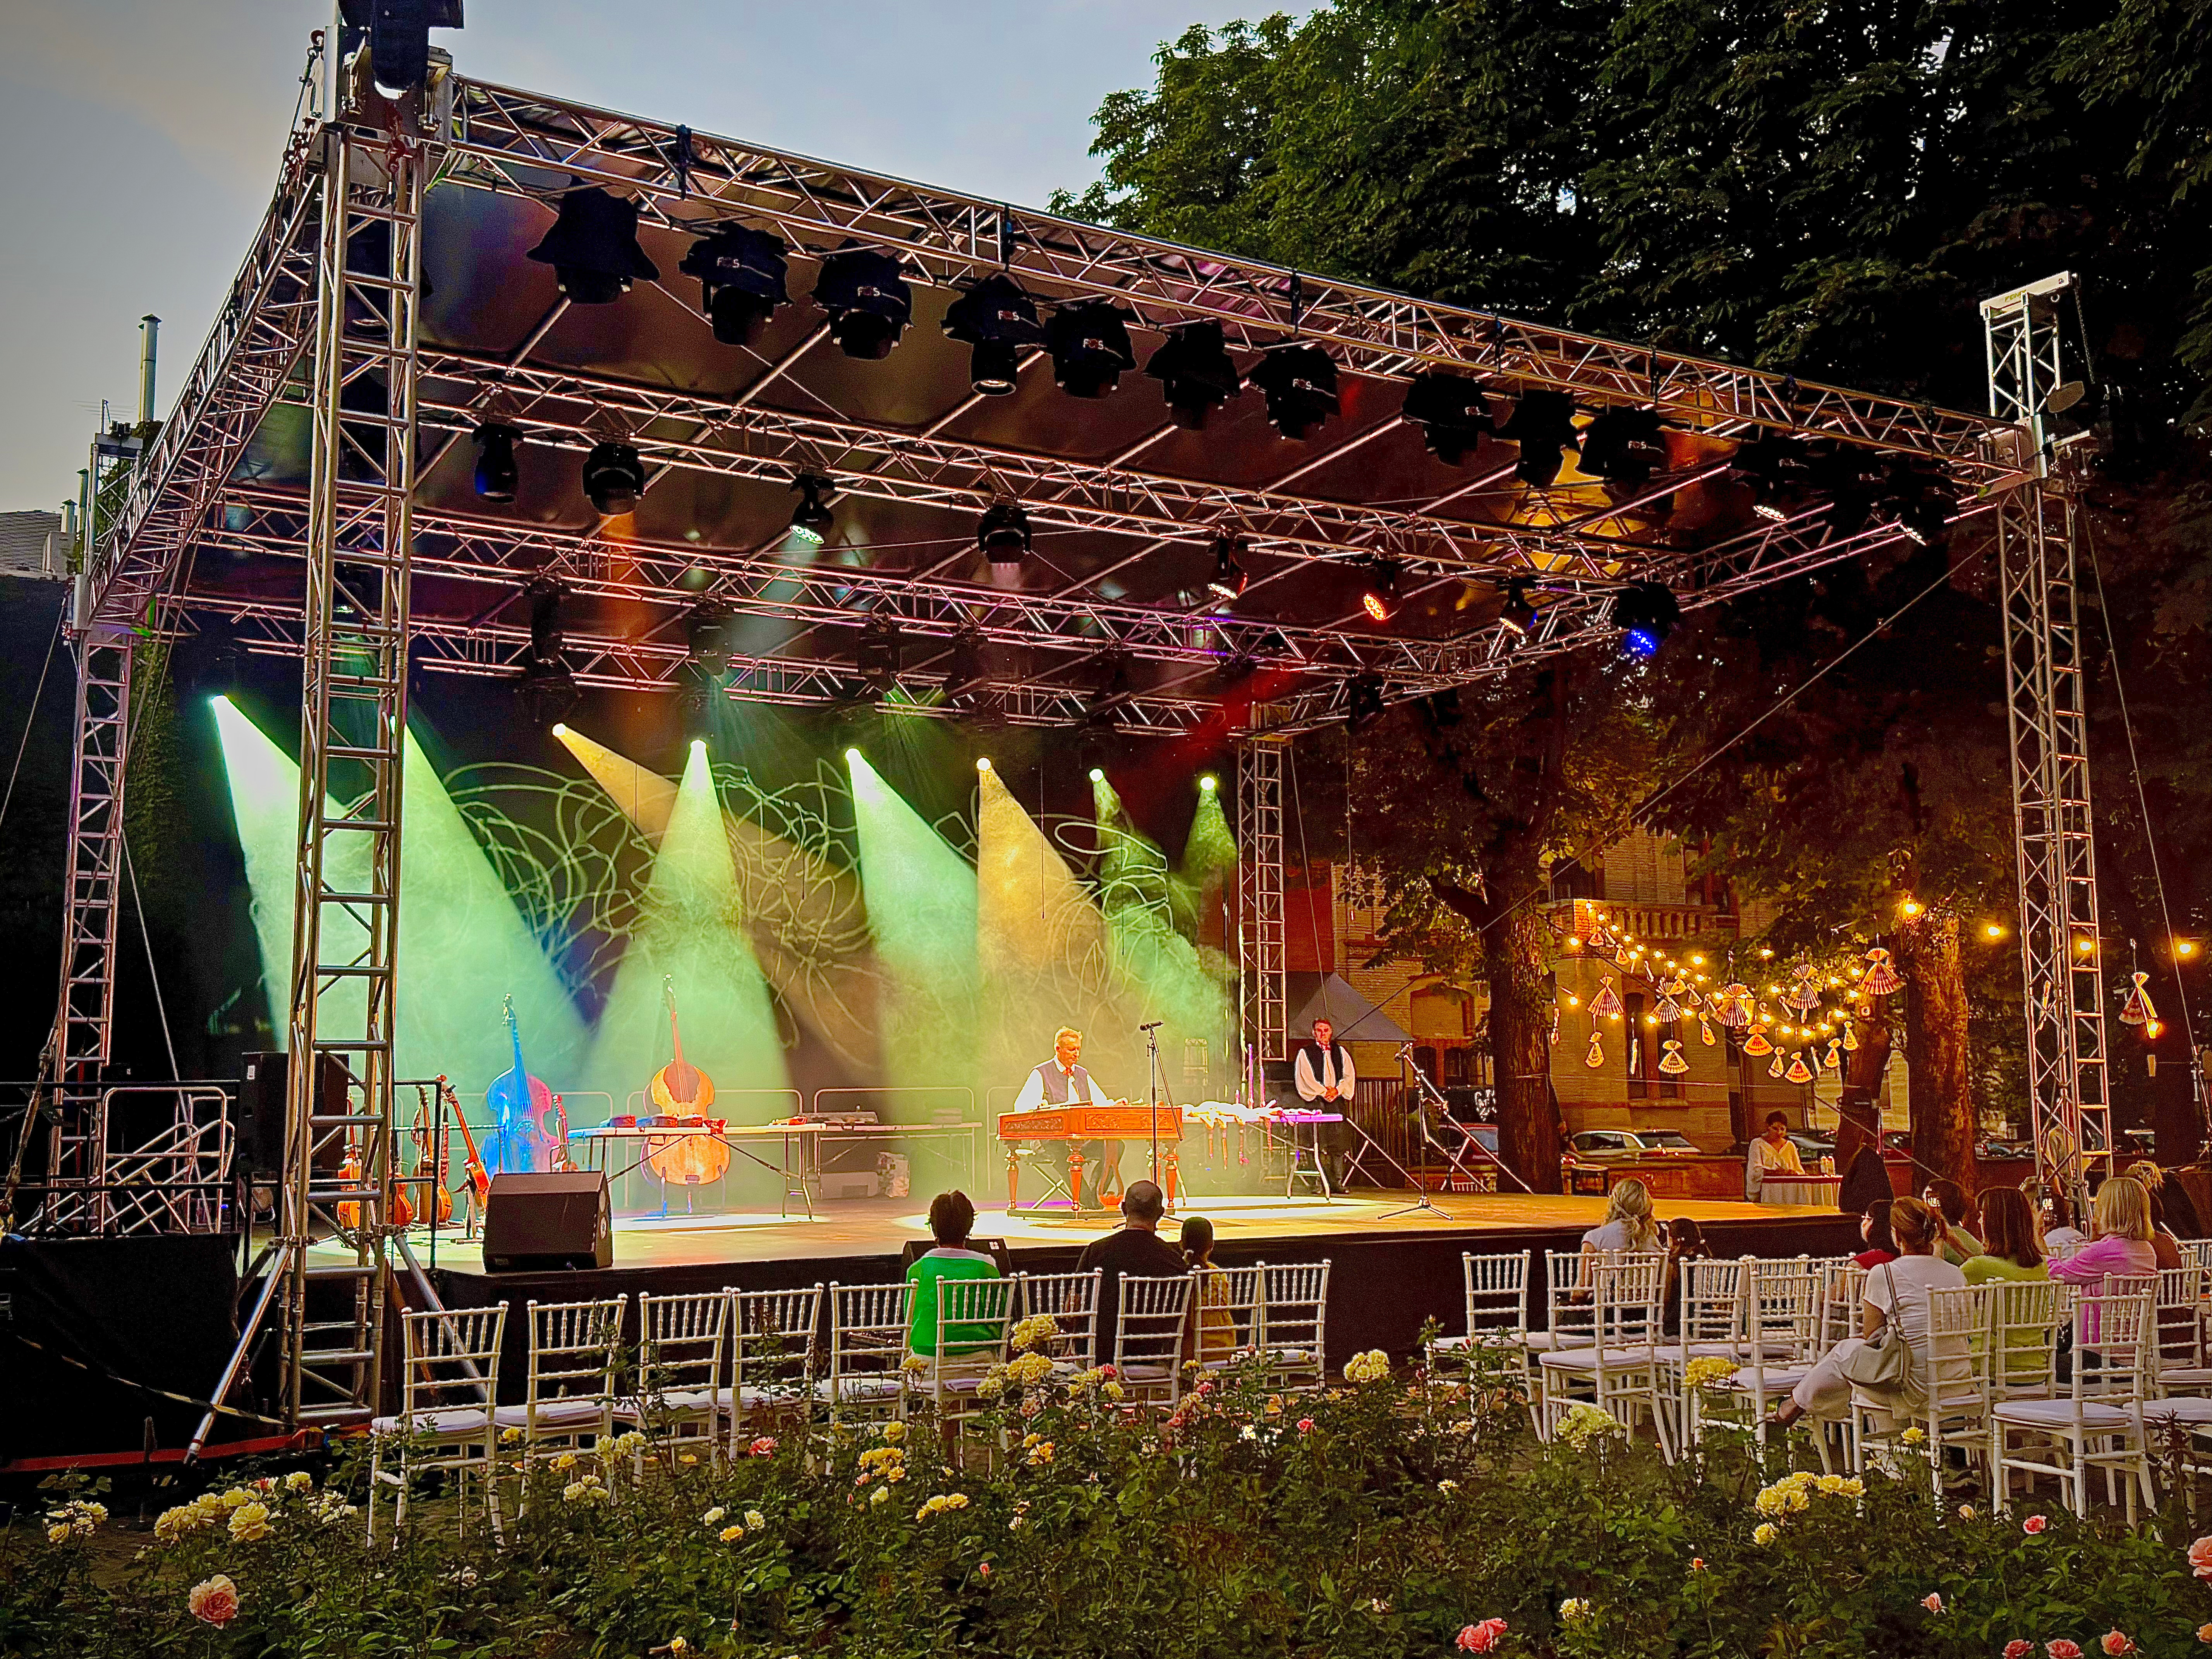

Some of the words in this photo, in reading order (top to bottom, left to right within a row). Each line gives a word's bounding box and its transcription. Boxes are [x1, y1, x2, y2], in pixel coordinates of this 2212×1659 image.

[1083, 339, 1104, 349] FOS
[1292, 378, 1312, 390] FOS
[1628, 440, 1646, 449] FOS
